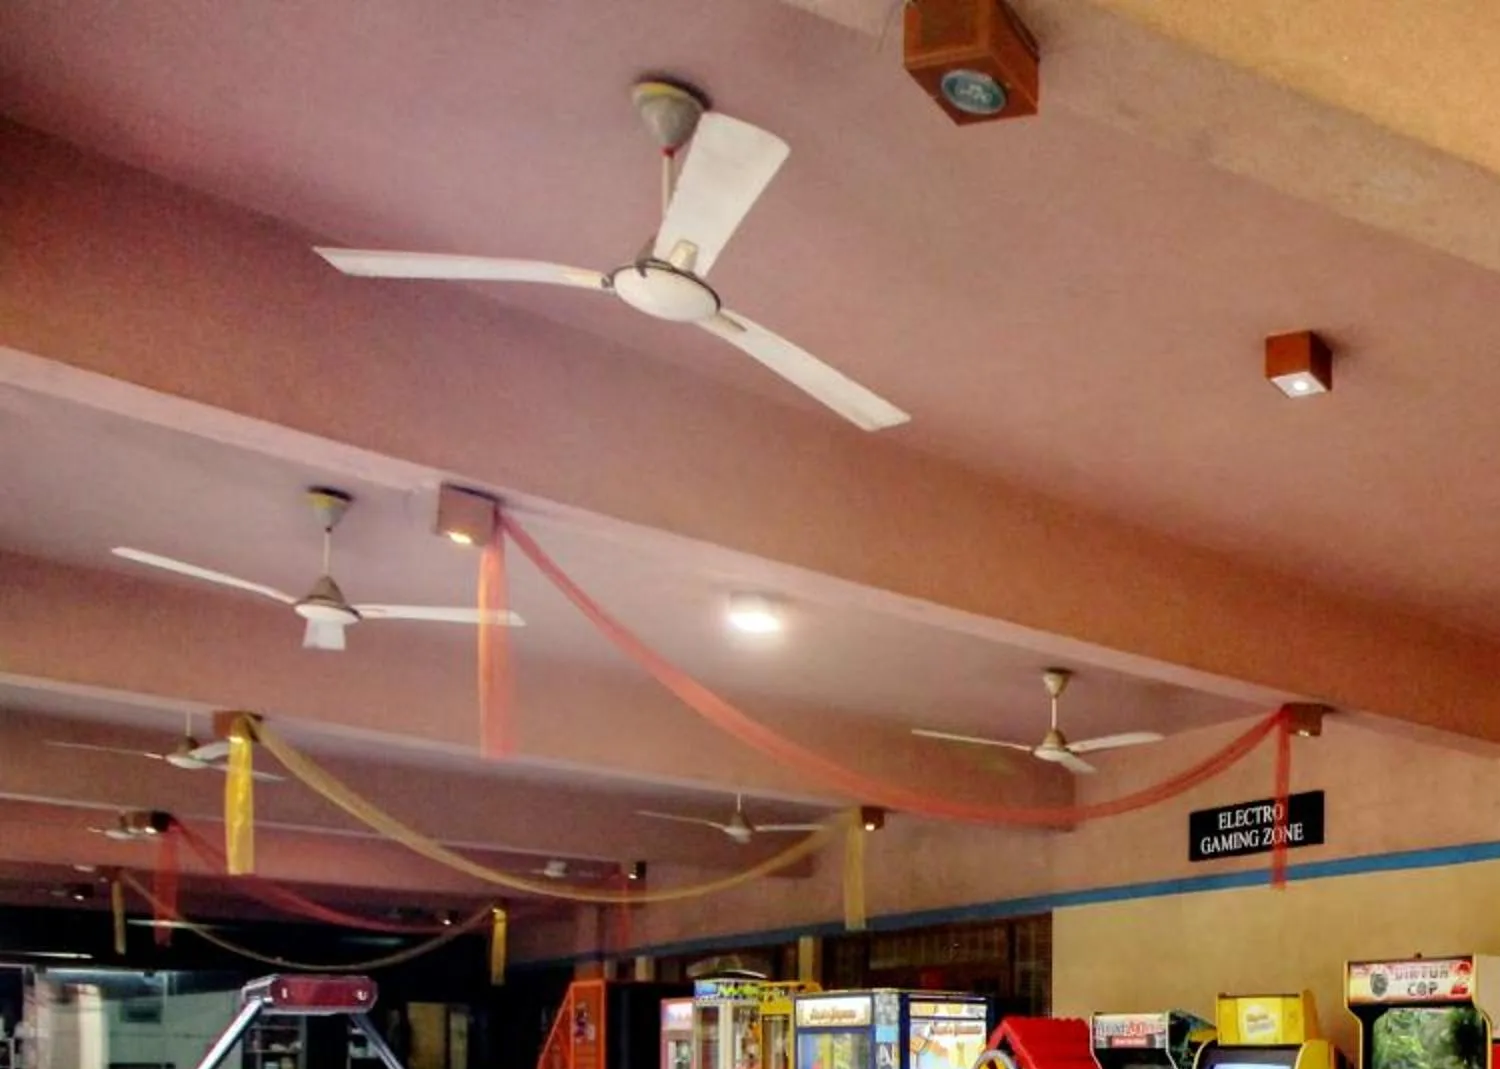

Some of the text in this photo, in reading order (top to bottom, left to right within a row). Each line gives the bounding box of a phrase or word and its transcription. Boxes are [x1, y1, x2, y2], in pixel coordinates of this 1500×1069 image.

[1218, 803, 1284, 830] ELECTRO
[1200, 823, 1304, 855] GAMING ZONE
